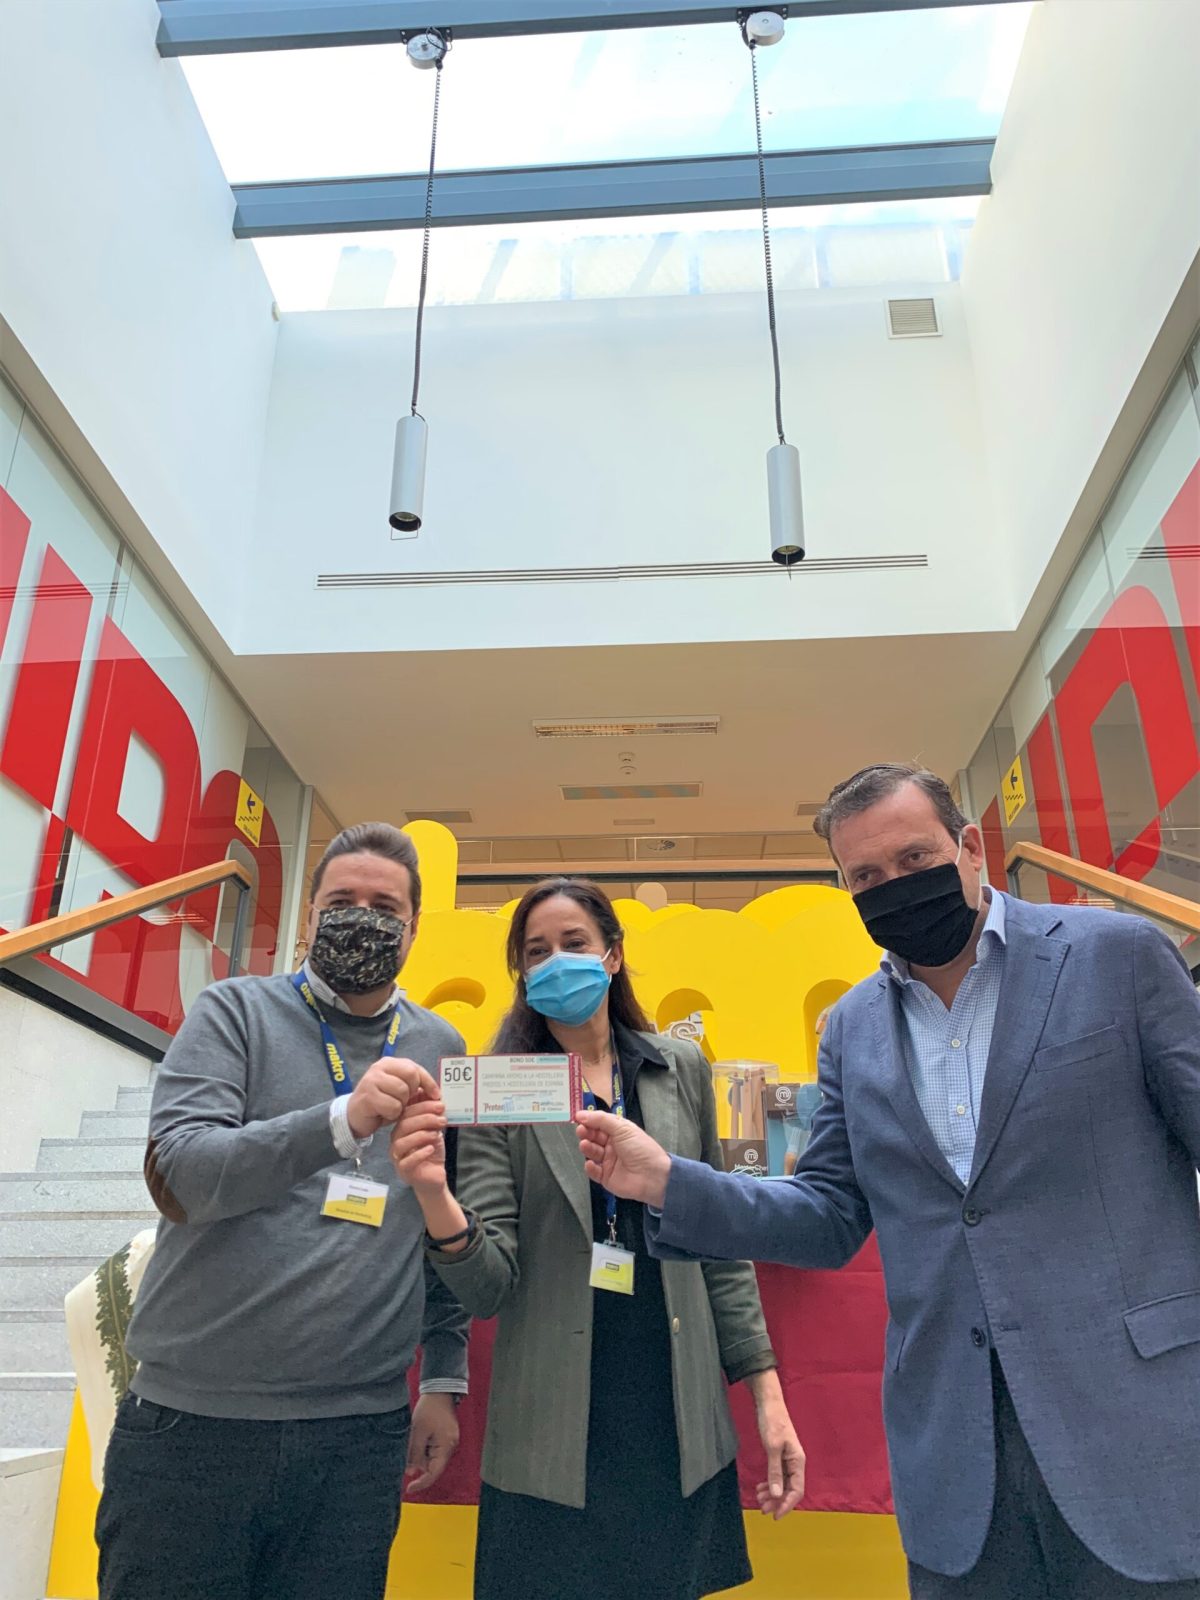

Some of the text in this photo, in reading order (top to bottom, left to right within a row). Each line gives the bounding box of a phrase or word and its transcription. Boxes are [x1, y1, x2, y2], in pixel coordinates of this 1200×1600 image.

[387, 1011, 400, 1045] makro
[326, 1043, 345, 1081] makro
[444, 1066, 472, 1082] 50€
